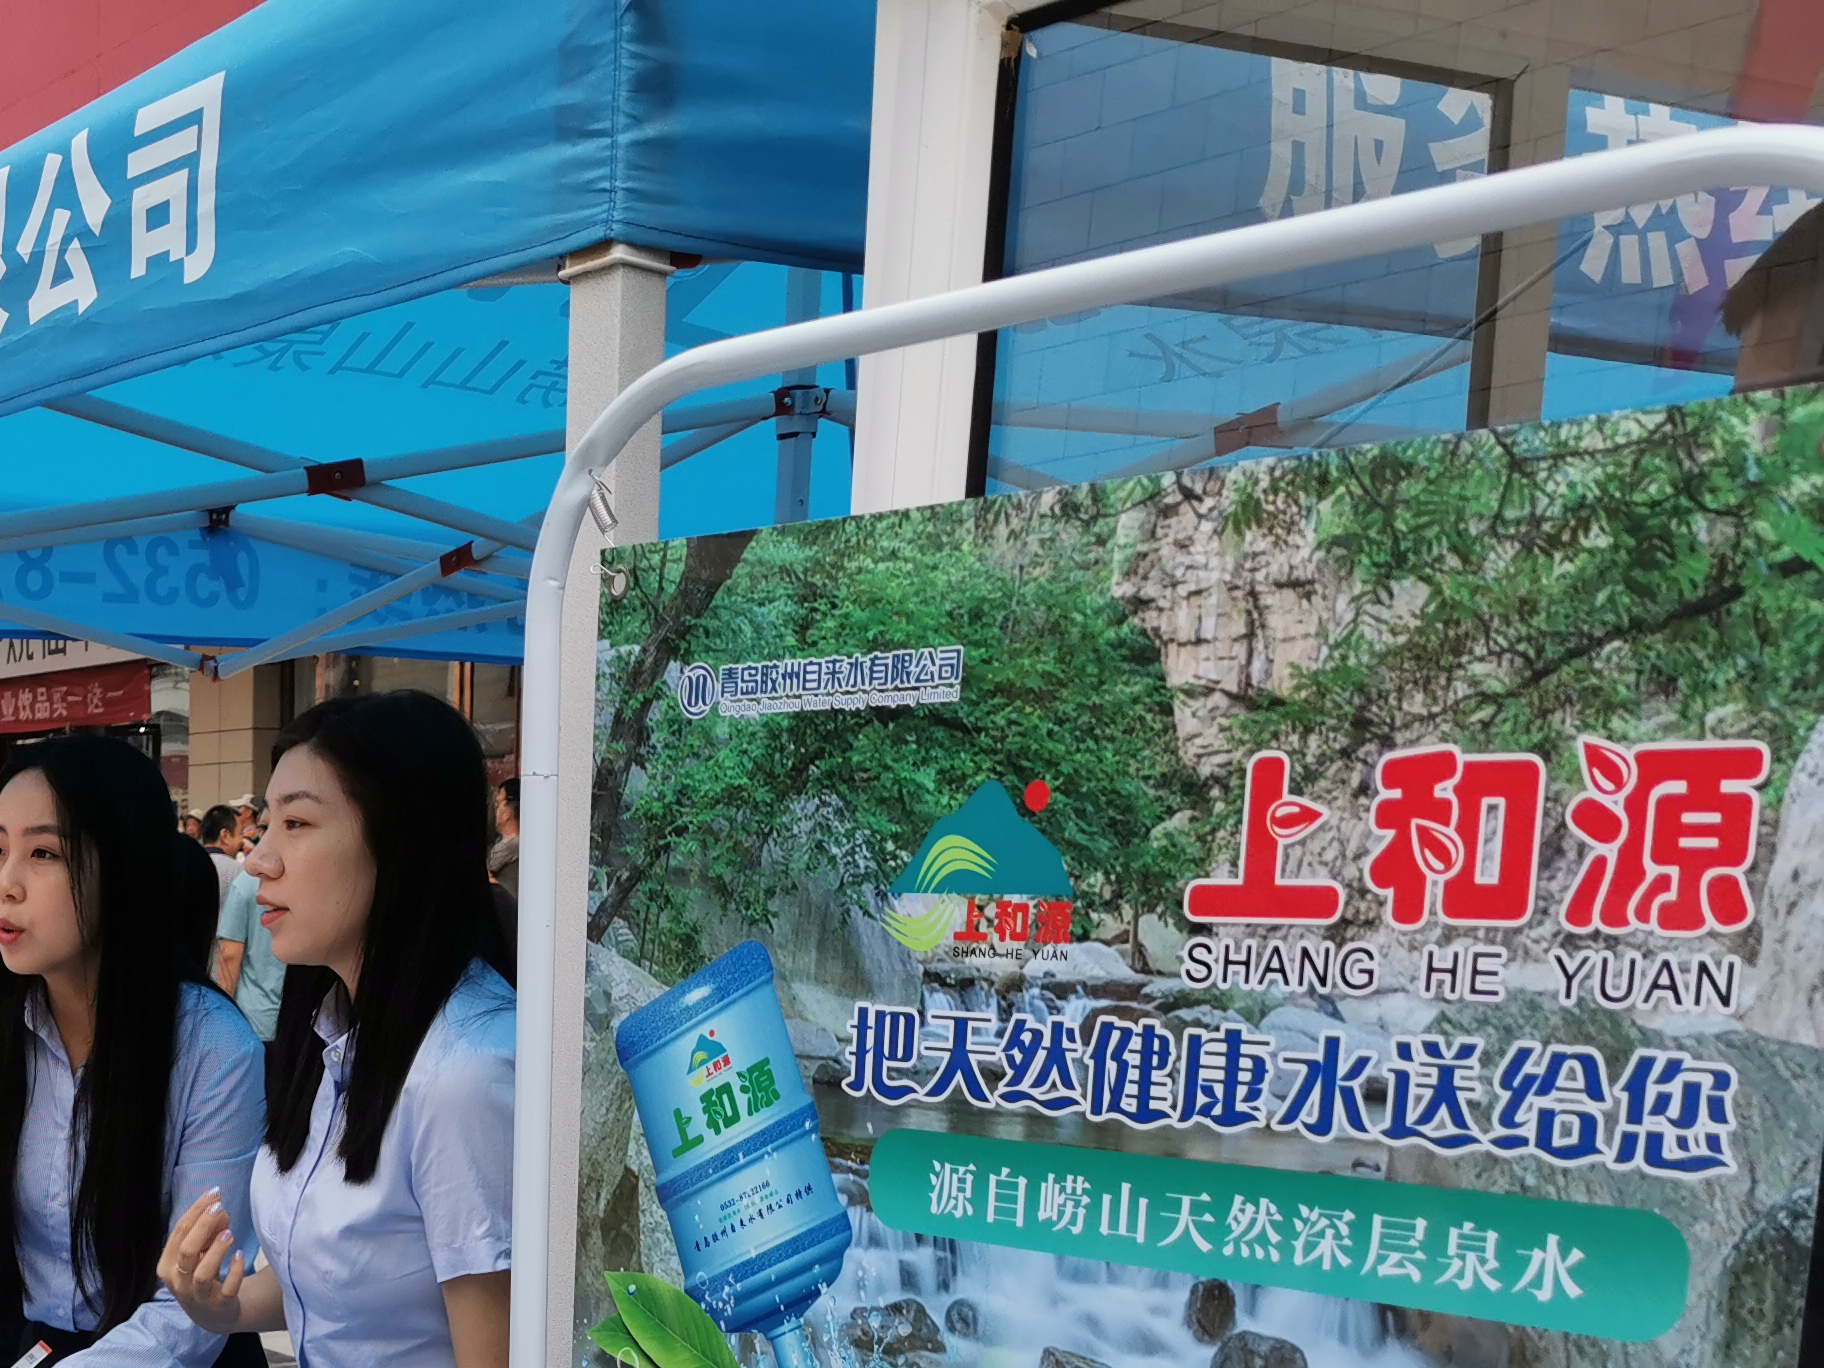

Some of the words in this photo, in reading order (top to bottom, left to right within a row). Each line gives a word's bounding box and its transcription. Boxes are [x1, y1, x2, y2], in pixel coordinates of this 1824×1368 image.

[719, 647, 962, 698] 青岛胶州自来水有限公司
[719, 701, 758, 714] Qingdao
[759, 699, 800, 712] Jiaozhou
[802, 696, 832, 709] Water
[833, 694, 869, 709] Supply
[870, 690, 918, 707] Company
[920, 686, 959, 701] Limited
[1186, 740, 1767, 932] 上和源
[953, 899, 1072, 944] 上和源
[952, 946, 998, 959] SHANG
[1005, 948, 1023, 960] HE
[1031, 949, 1069, 962] YUAN
[1184, 942, 1376, 991] SHANG
[1424, 948, 1506, 997] HE
[1554, 953, 1737, 1008] YUAN
[705, 1053, 732, 1079] 上和源
[846, 1006, 1734, 1173] 把天然健康水送给您
[671, 1057, 781, 1159] 上和源
[928, 1160, 1586, 1302] 源自崂山天然深层泉水
